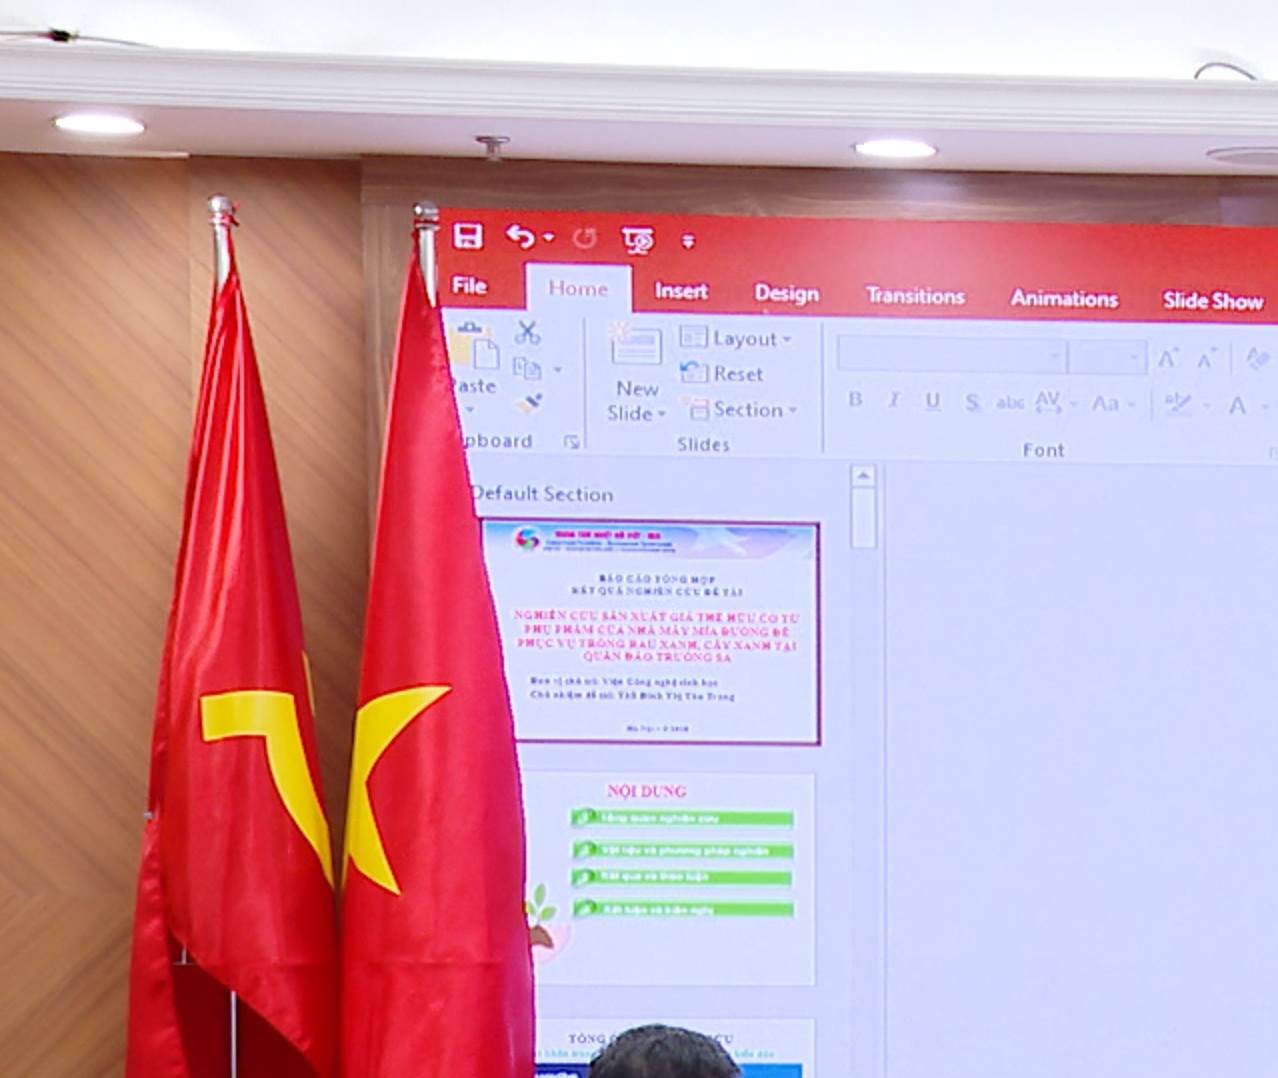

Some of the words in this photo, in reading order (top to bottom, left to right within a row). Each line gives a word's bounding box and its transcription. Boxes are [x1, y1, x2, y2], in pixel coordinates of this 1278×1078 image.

[453, 275, 488, 294] File
[550, 280, 608, 296] Home
[656, 282, 709, 299] Insert
[754, 283, 819, 306] Design
[866, 285, 965, 304] Transitions
[1011, 289, 1120, 309] Animations
[1164, 290, 1208, 310] Slide
[1212, 291, 1263, 311] Show
[711, 330, 776, 350] Layout
[715, 365, 763, 381] Reset
[459, 379, 496, 393] aste
[617, 381, 658, 396] New
[608, 405, 652, 421] Slide
[715, 401, 782, 417] Section
[466, 434, 532, 449] pboard
[678, 437, 730, 452] Slides
[1022, 443, 1064, 457] Font
[545, 486, 613, 501] Section
[608, 784, 636, 800] NỘI
[641, 785, 686, 798] DUNG
